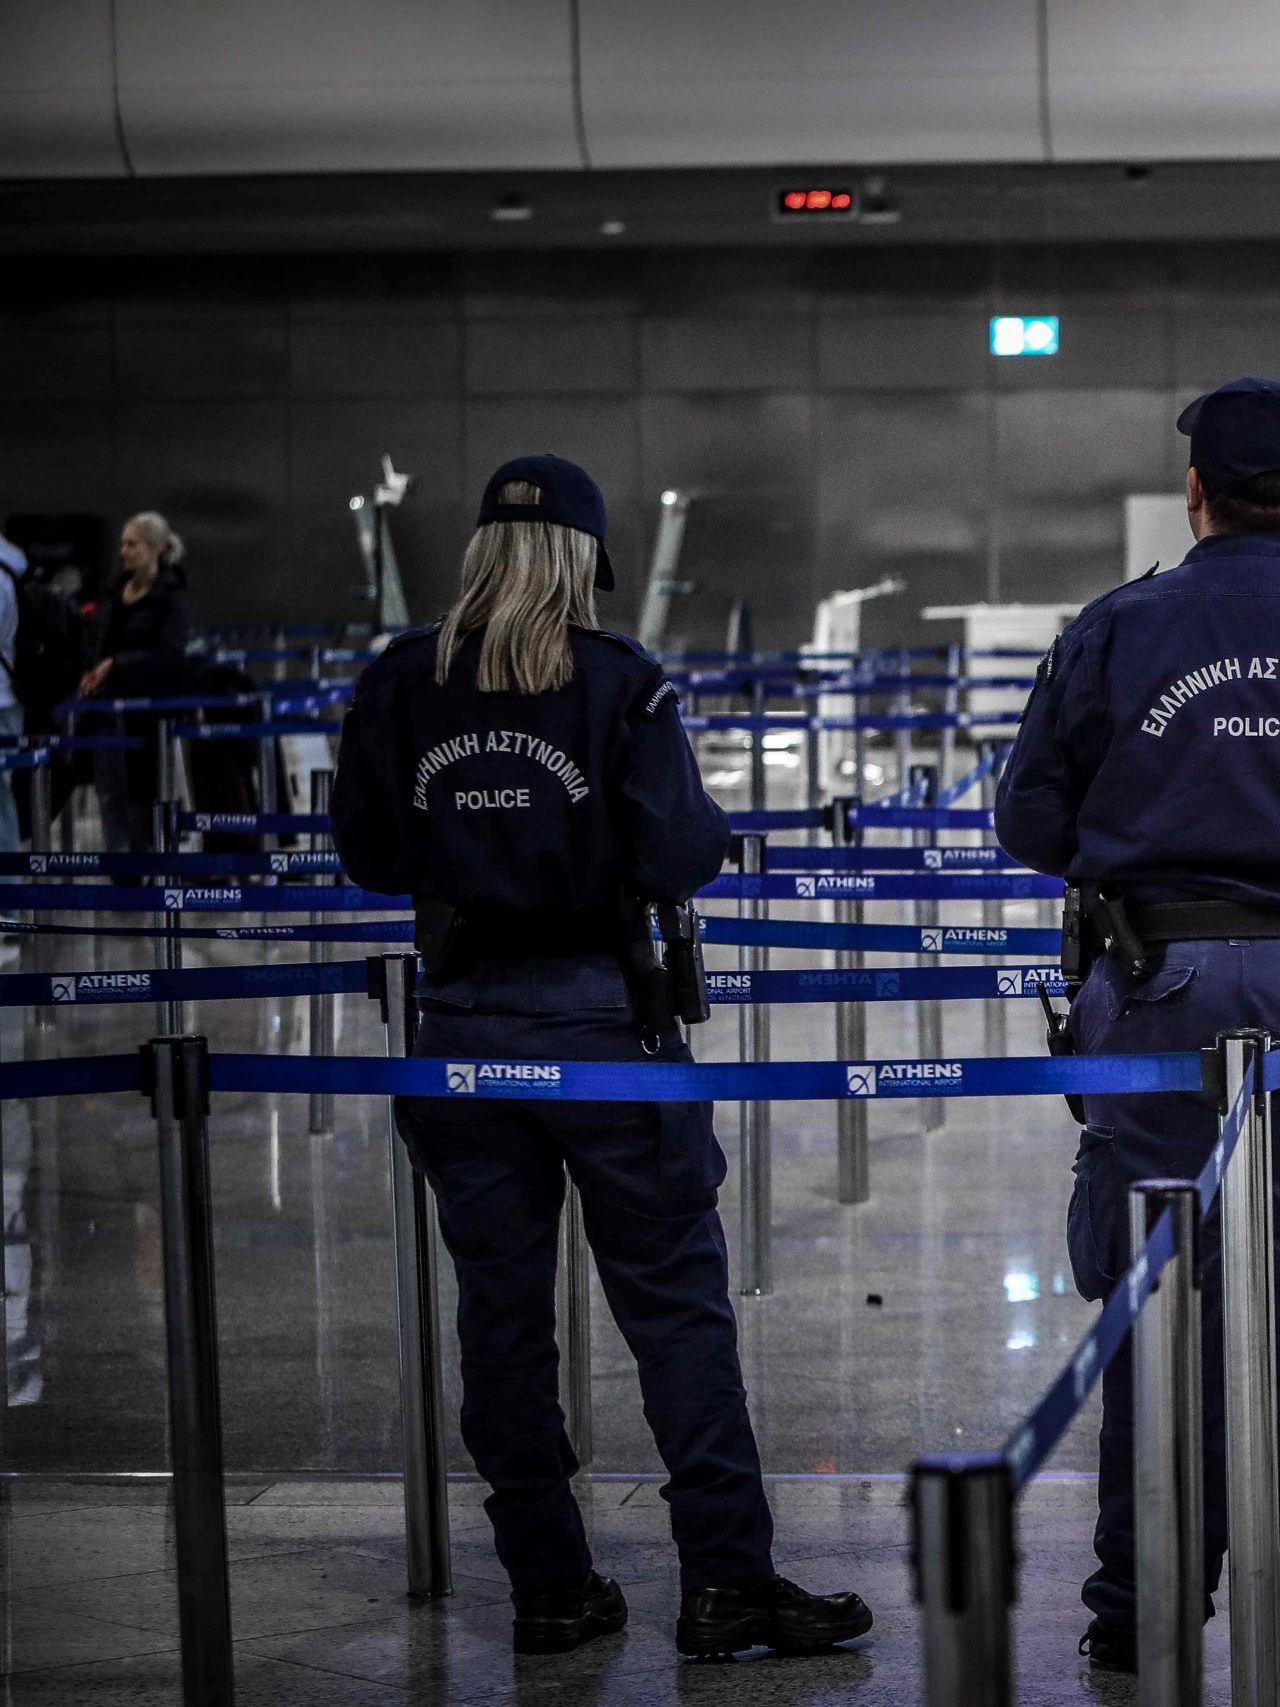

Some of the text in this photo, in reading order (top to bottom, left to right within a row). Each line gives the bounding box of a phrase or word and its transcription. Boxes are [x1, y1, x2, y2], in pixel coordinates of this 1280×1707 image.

[1141, 658, 1241, 737] ΕΛΛΗΝΙΚΗ
[413, 730, 591, 811] ΕΛΛΗΝΙΚΗ ΑΣΤΥΝΟΜΙΑ
[455, 789, 531, 811] POLICE
[212, 814, 257, 825] ATHENS
[48, 854, 100, 866] ATHENS
[943, 849, 997, 860] ATHENS
[817, 877, 875, 888] ATHENS
[185, 888, 242, 900] ATHENS
[239, 927, 295, 935] ATHENS
[944, 929, 1008, 941] ATHENS
[78, 973, 152, 988] ATHENS
[705, 975, 752, 988] HENS
[1024, 968, 1064, 982] ATH
[478, 1064, 562, 1080] ATHENS
[878, 1063, 963, 1079] ATHENS
